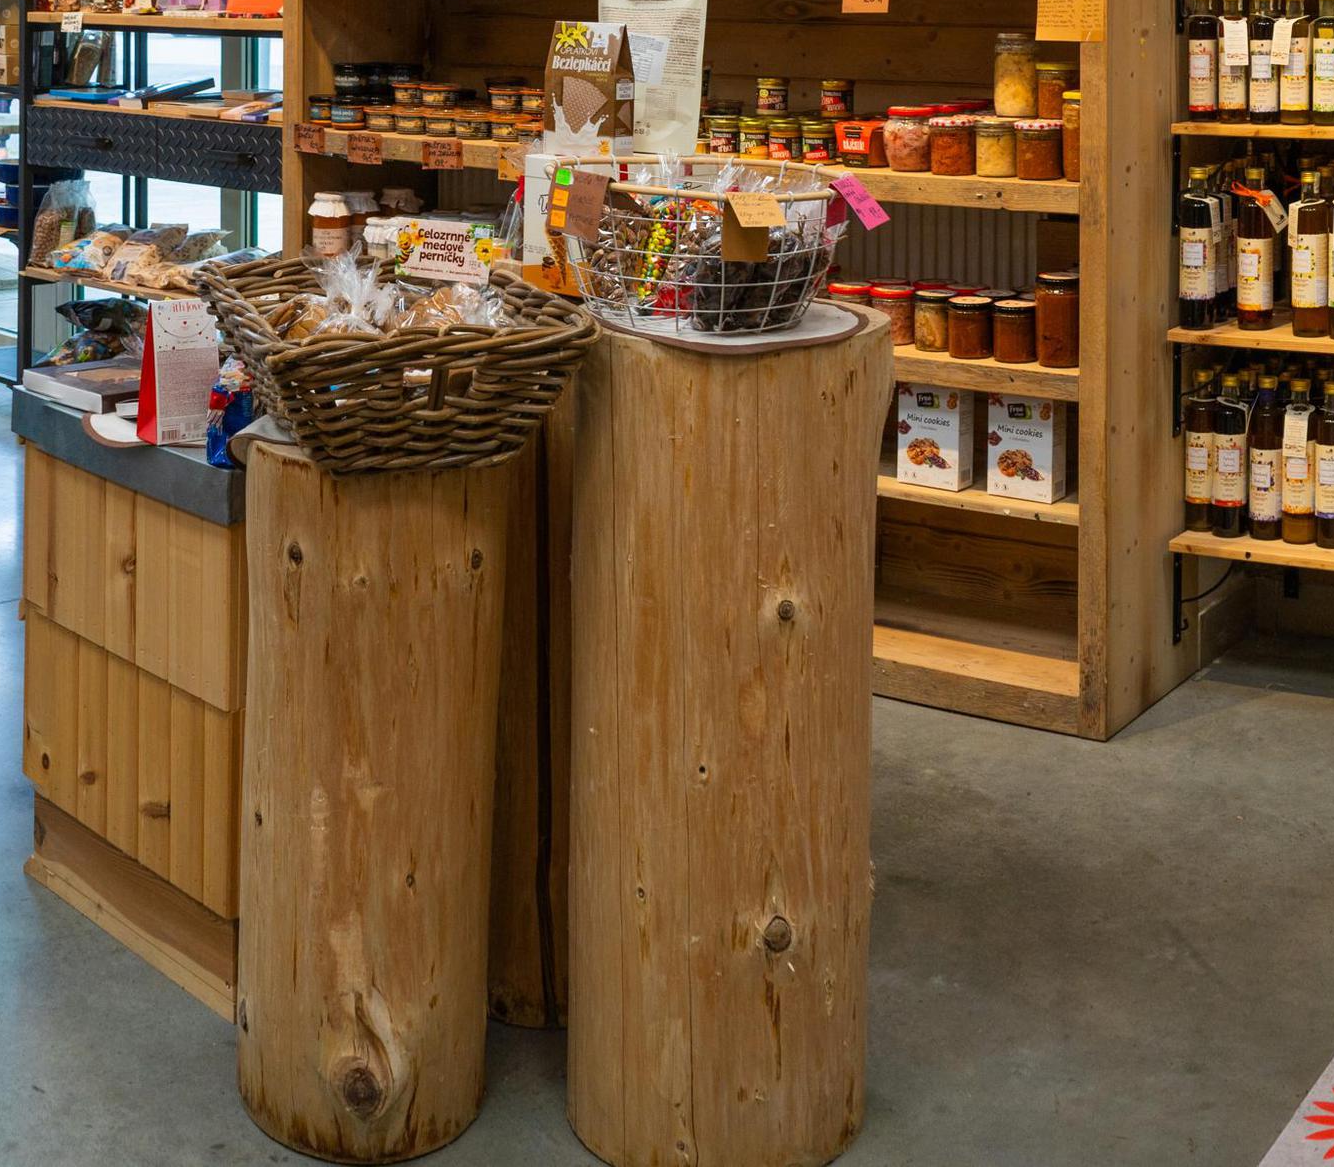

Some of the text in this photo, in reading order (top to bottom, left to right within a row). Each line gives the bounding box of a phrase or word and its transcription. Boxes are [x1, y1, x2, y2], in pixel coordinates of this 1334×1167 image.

[418, 228, 471, 243] Celozrnné
[423, 239, 464, 253] medové
[419, 251, 465, 267] perníčky
[906, 412, 951, 427] Mini cookies
[997, 424, 1044, 439] Mini cookies
